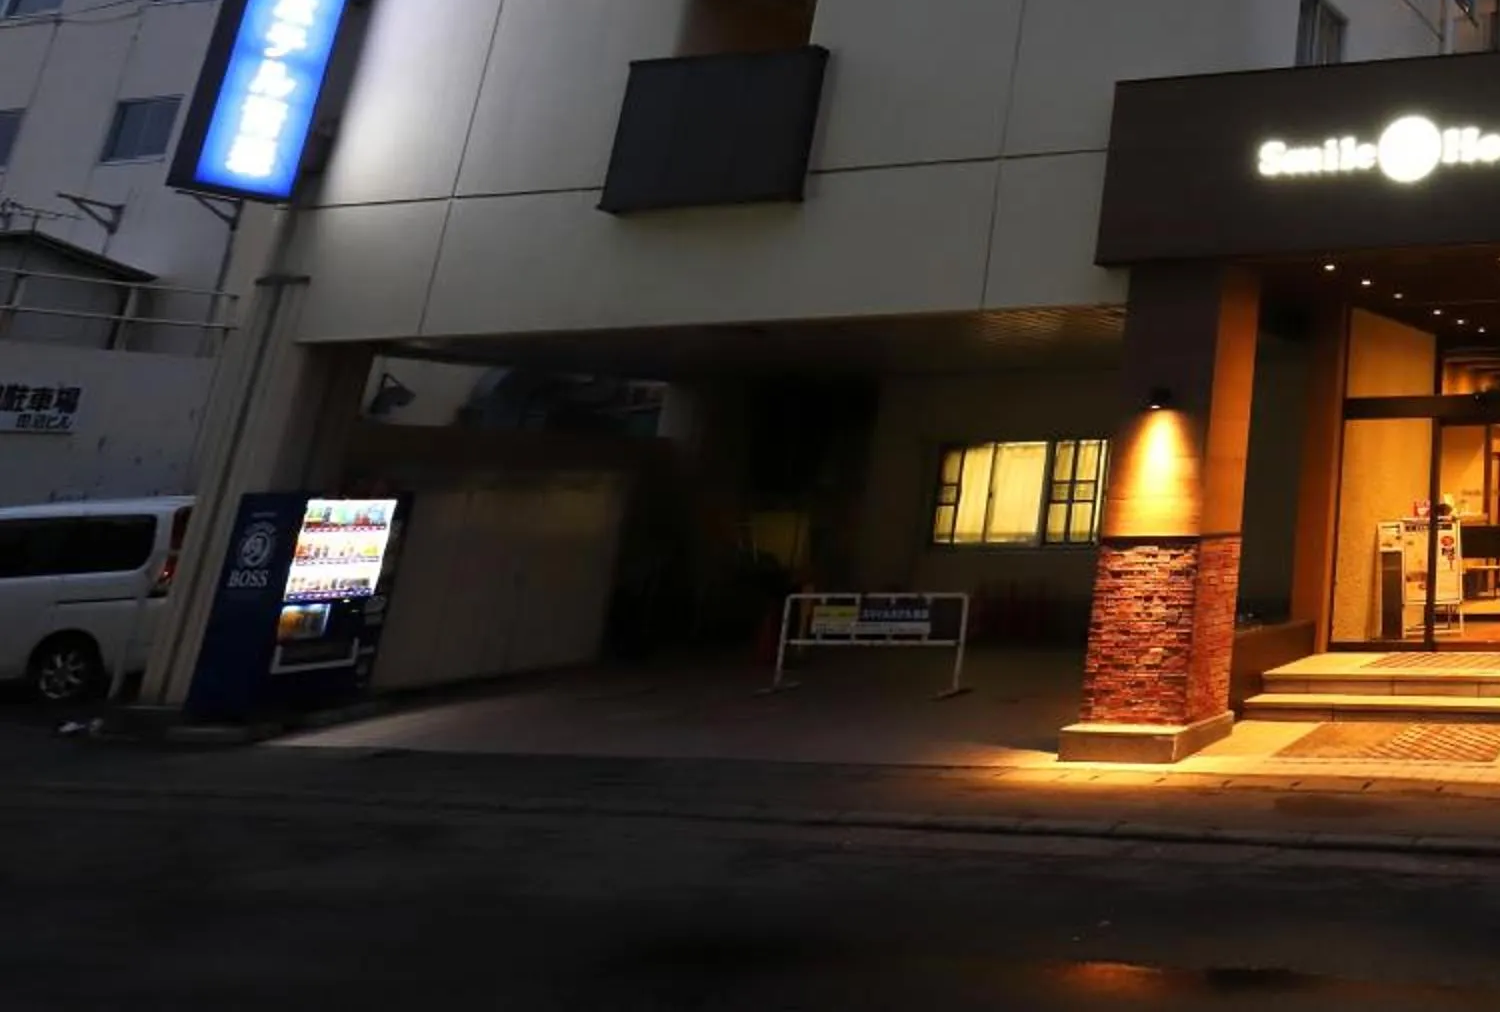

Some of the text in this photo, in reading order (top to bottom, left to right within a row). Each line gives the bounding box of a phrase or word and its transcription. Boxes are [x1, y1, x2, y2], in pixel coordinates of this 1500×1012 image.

[0, 383, 81, 414] 駐車場
[227, 568, 271, 588] BOSS
